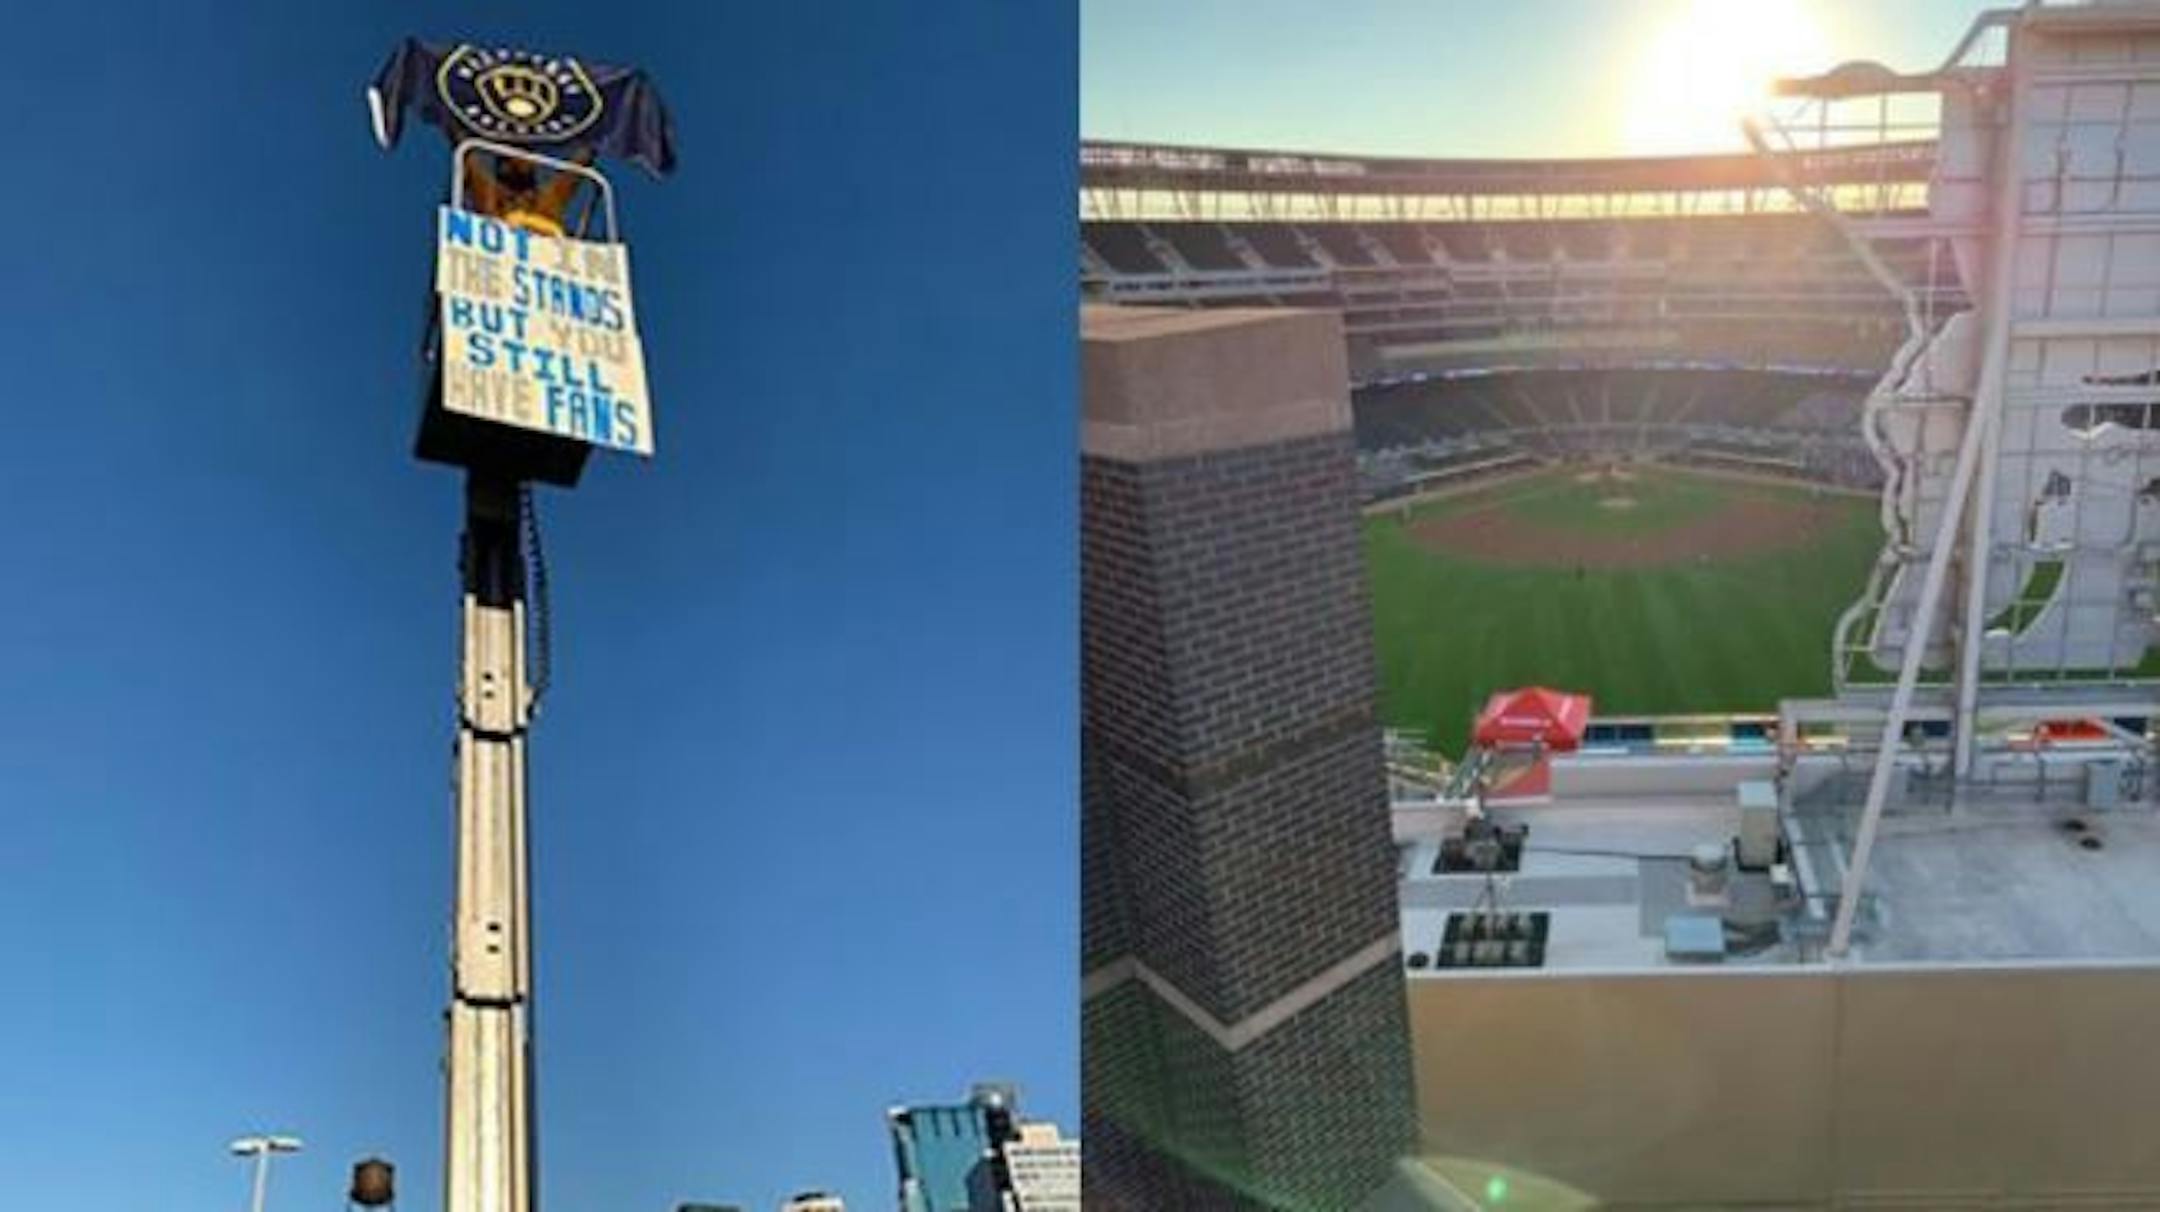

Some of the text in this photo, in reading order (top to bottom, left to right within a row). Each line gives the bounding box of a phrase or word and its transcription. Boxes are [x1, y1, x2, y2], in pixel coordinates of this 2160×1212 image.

[447, 212, 530, 261] NOT
[450, 250, 624, 331] THE STANDS
[451, 297, 529, 338] BUT
[468, 333, 613, 393] STILL
[547, 385, 638, 447] FANS
